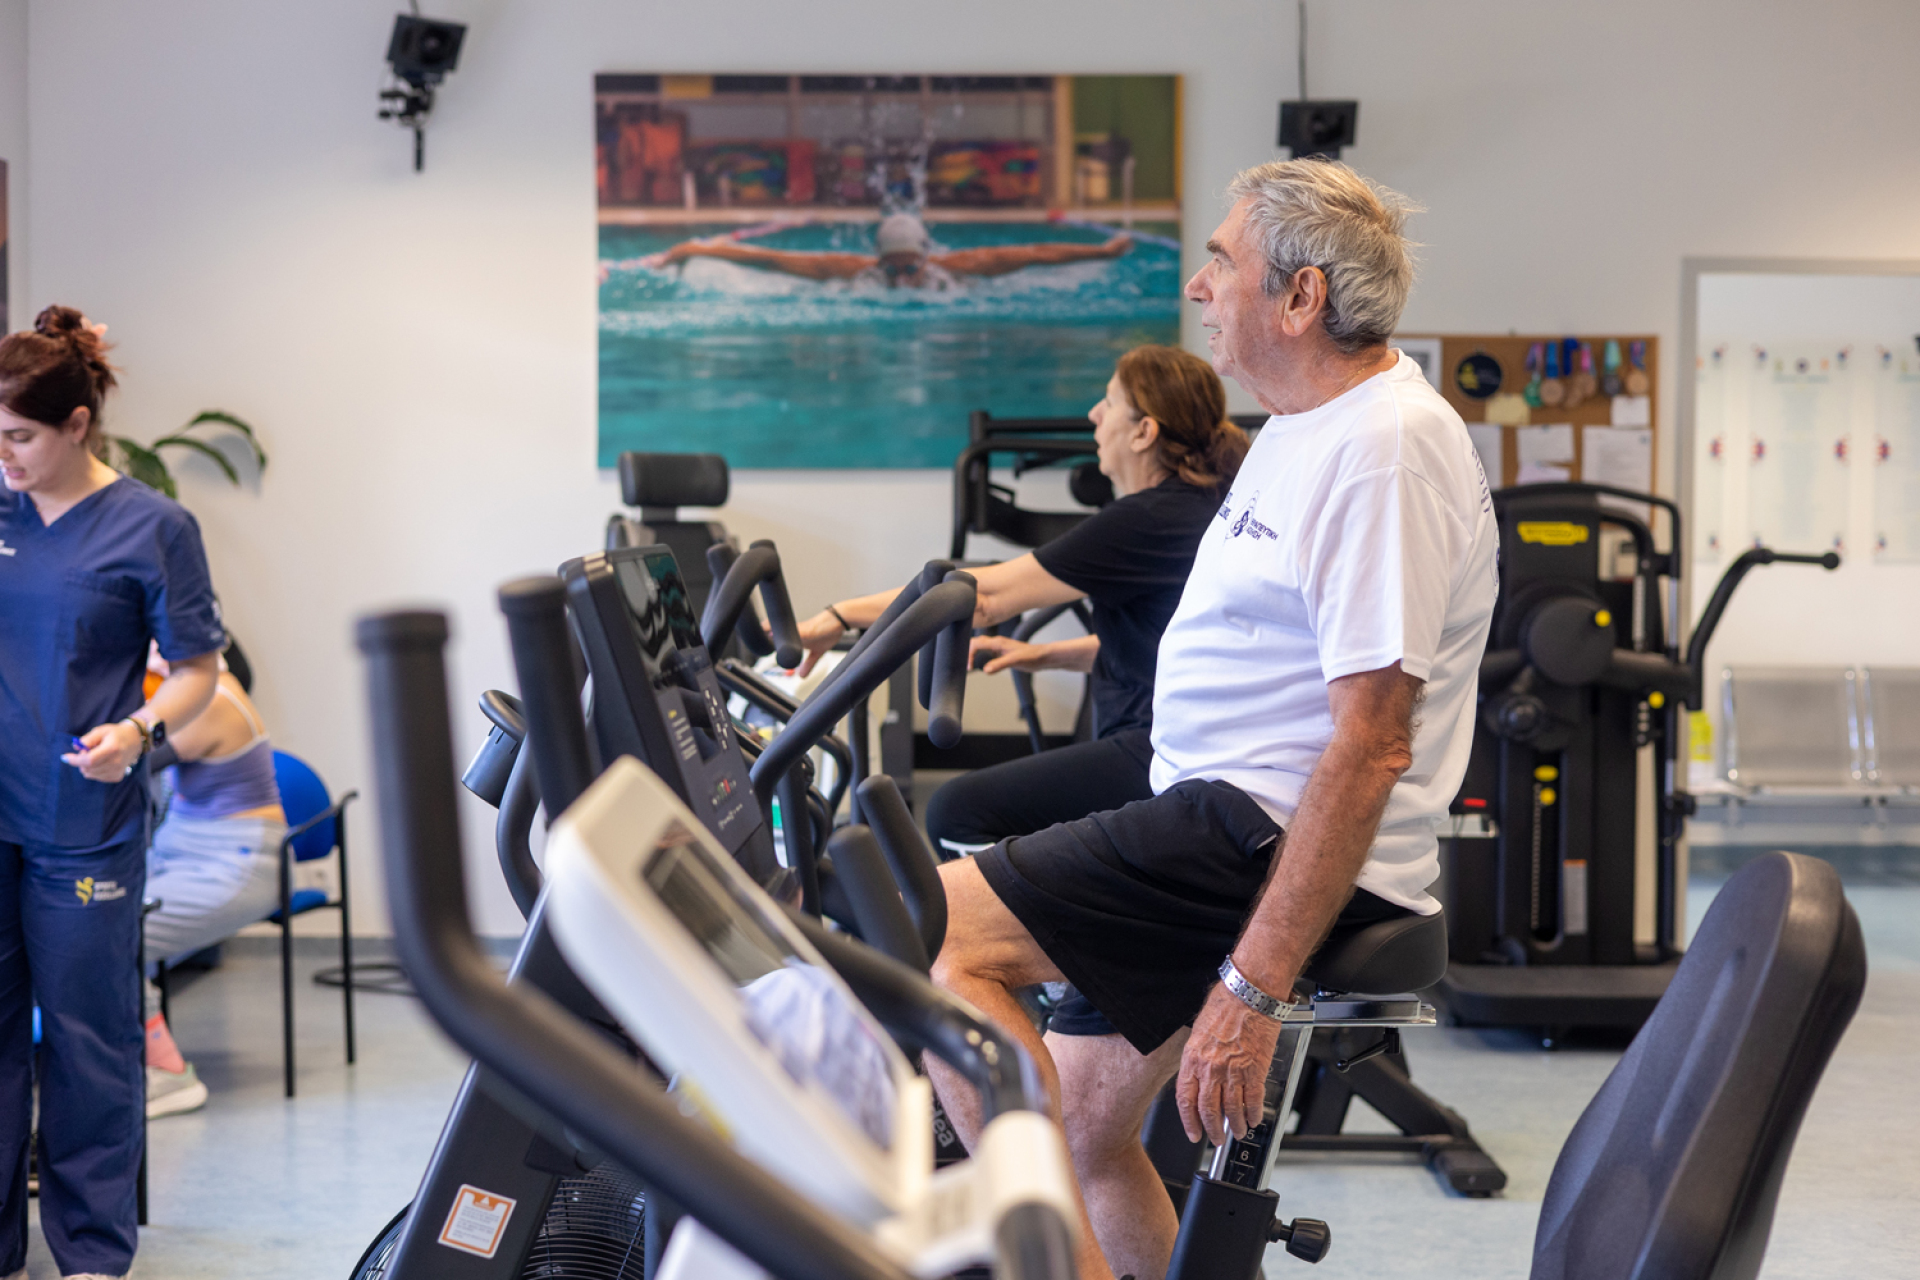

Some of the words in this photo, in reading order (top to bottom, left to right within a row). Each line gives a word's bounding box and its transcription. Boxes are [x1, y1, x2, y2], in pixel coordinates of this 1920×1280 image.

[1246, 1129, 1255, 1140] 5
[1241, 1150, 1249, 1161] 6
[1237, 1171, 1245, 1183] 7
